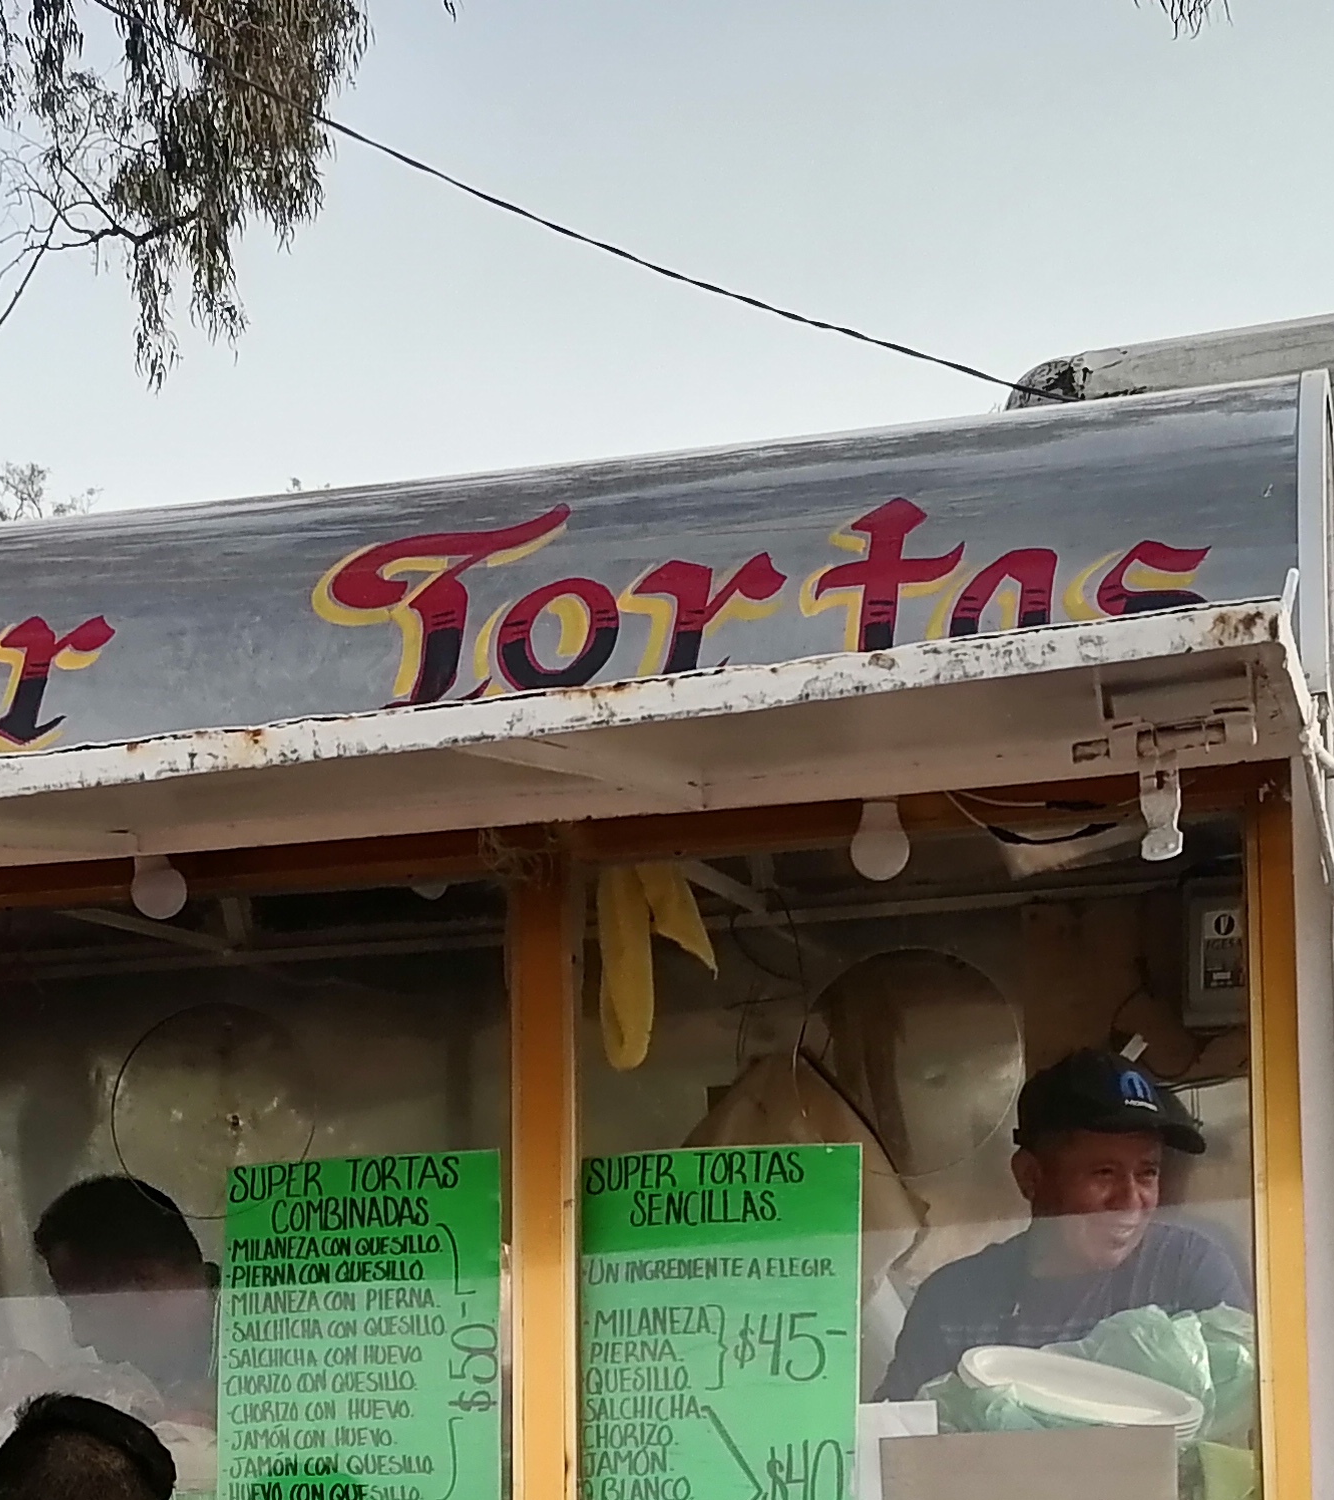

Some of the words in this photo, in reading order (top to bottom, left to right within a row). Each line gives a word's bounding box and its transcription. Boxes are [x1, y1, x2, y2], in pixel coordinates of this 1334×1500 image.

[312, 497, 1211, 708] Tortas
[229, 1160, 323, 1203] SUPER
[345, 1155, 460, 1193] TORTAS
[586, 1153, 677, 1196] SUPER
[693, 1151, 805, 1186] TORTAS
[271, 1195, 429, 1234] COMBINADAS
[231, 1236, 320, 1263] MILANEZA
[322, 1236, 351, 1257] CON
[231, 1262, 296, 1289] PIERNA
[298, 1262, 330, 1285] CON
[624, 1257, 743, 1284] INGREDIENTE
[748, 1257, 762, 1280] A
[766, 1256, 836, 1278] ELEGIR
[231, 1290, 320, 1317] MILANEZA
[323, 1290, 355, 1311] CON
[232, 1317, 323, 1343] SALCHICHA
[327, 1319, 357, 1339] CON
[228, 1347, 317, 1369] SALCHICHA
[323, 1344, 357, 1368] CON
[363, 1344, 423, 1365] HUEVO
[226, 1373, 292, 1397] CHORIZO
[297, 1369, 326, 1393] CON
[231, 1400, 299, 1425] CHORIZO
[305, 1399, 336, 1422] CON
[230, 1423, 290, 1451] JAMÓN
[294, 1429, 325, 1450] CON
[229, 1451, 298, 1479] JAMÓN
[303, 1452, 338, 1477] CON
